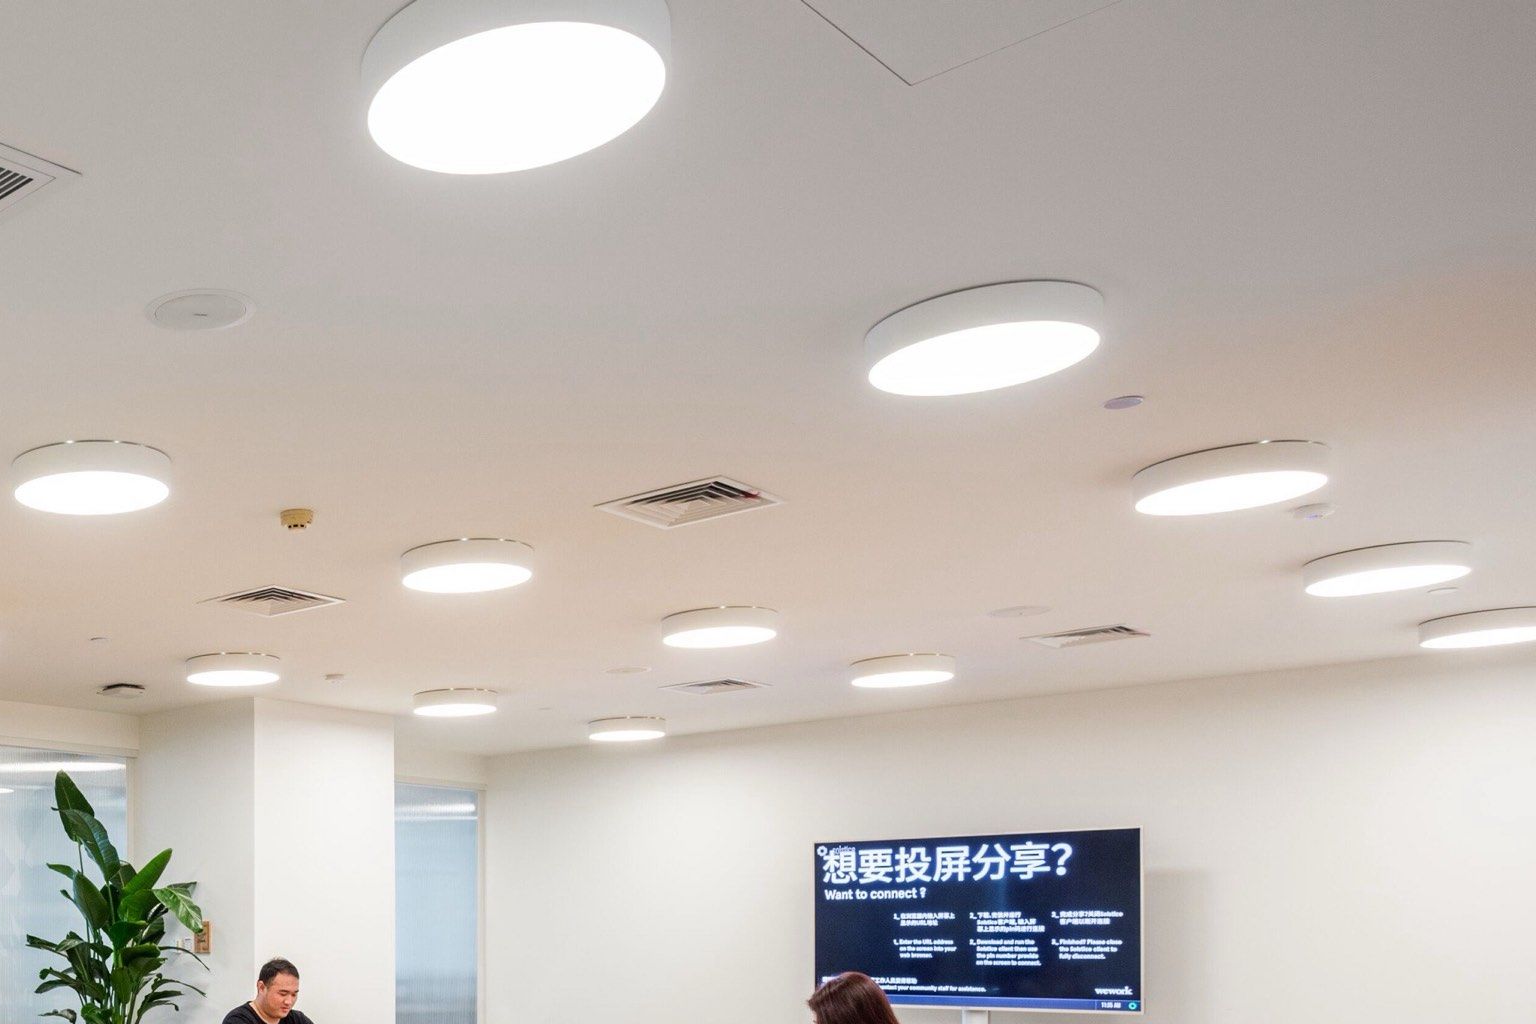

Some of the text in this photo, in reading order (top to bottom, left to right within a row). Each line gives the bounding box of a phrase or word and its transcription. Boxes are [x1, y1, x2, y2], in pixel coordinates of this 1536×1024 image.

[823, 841, 1073, 884] 想要投屏分享?
[825, 889, 853, 900] Want
[855, 889, 868, 899] to
[870, 888, 917, 899] connect
[1094, 985, 1133, 995] wework
